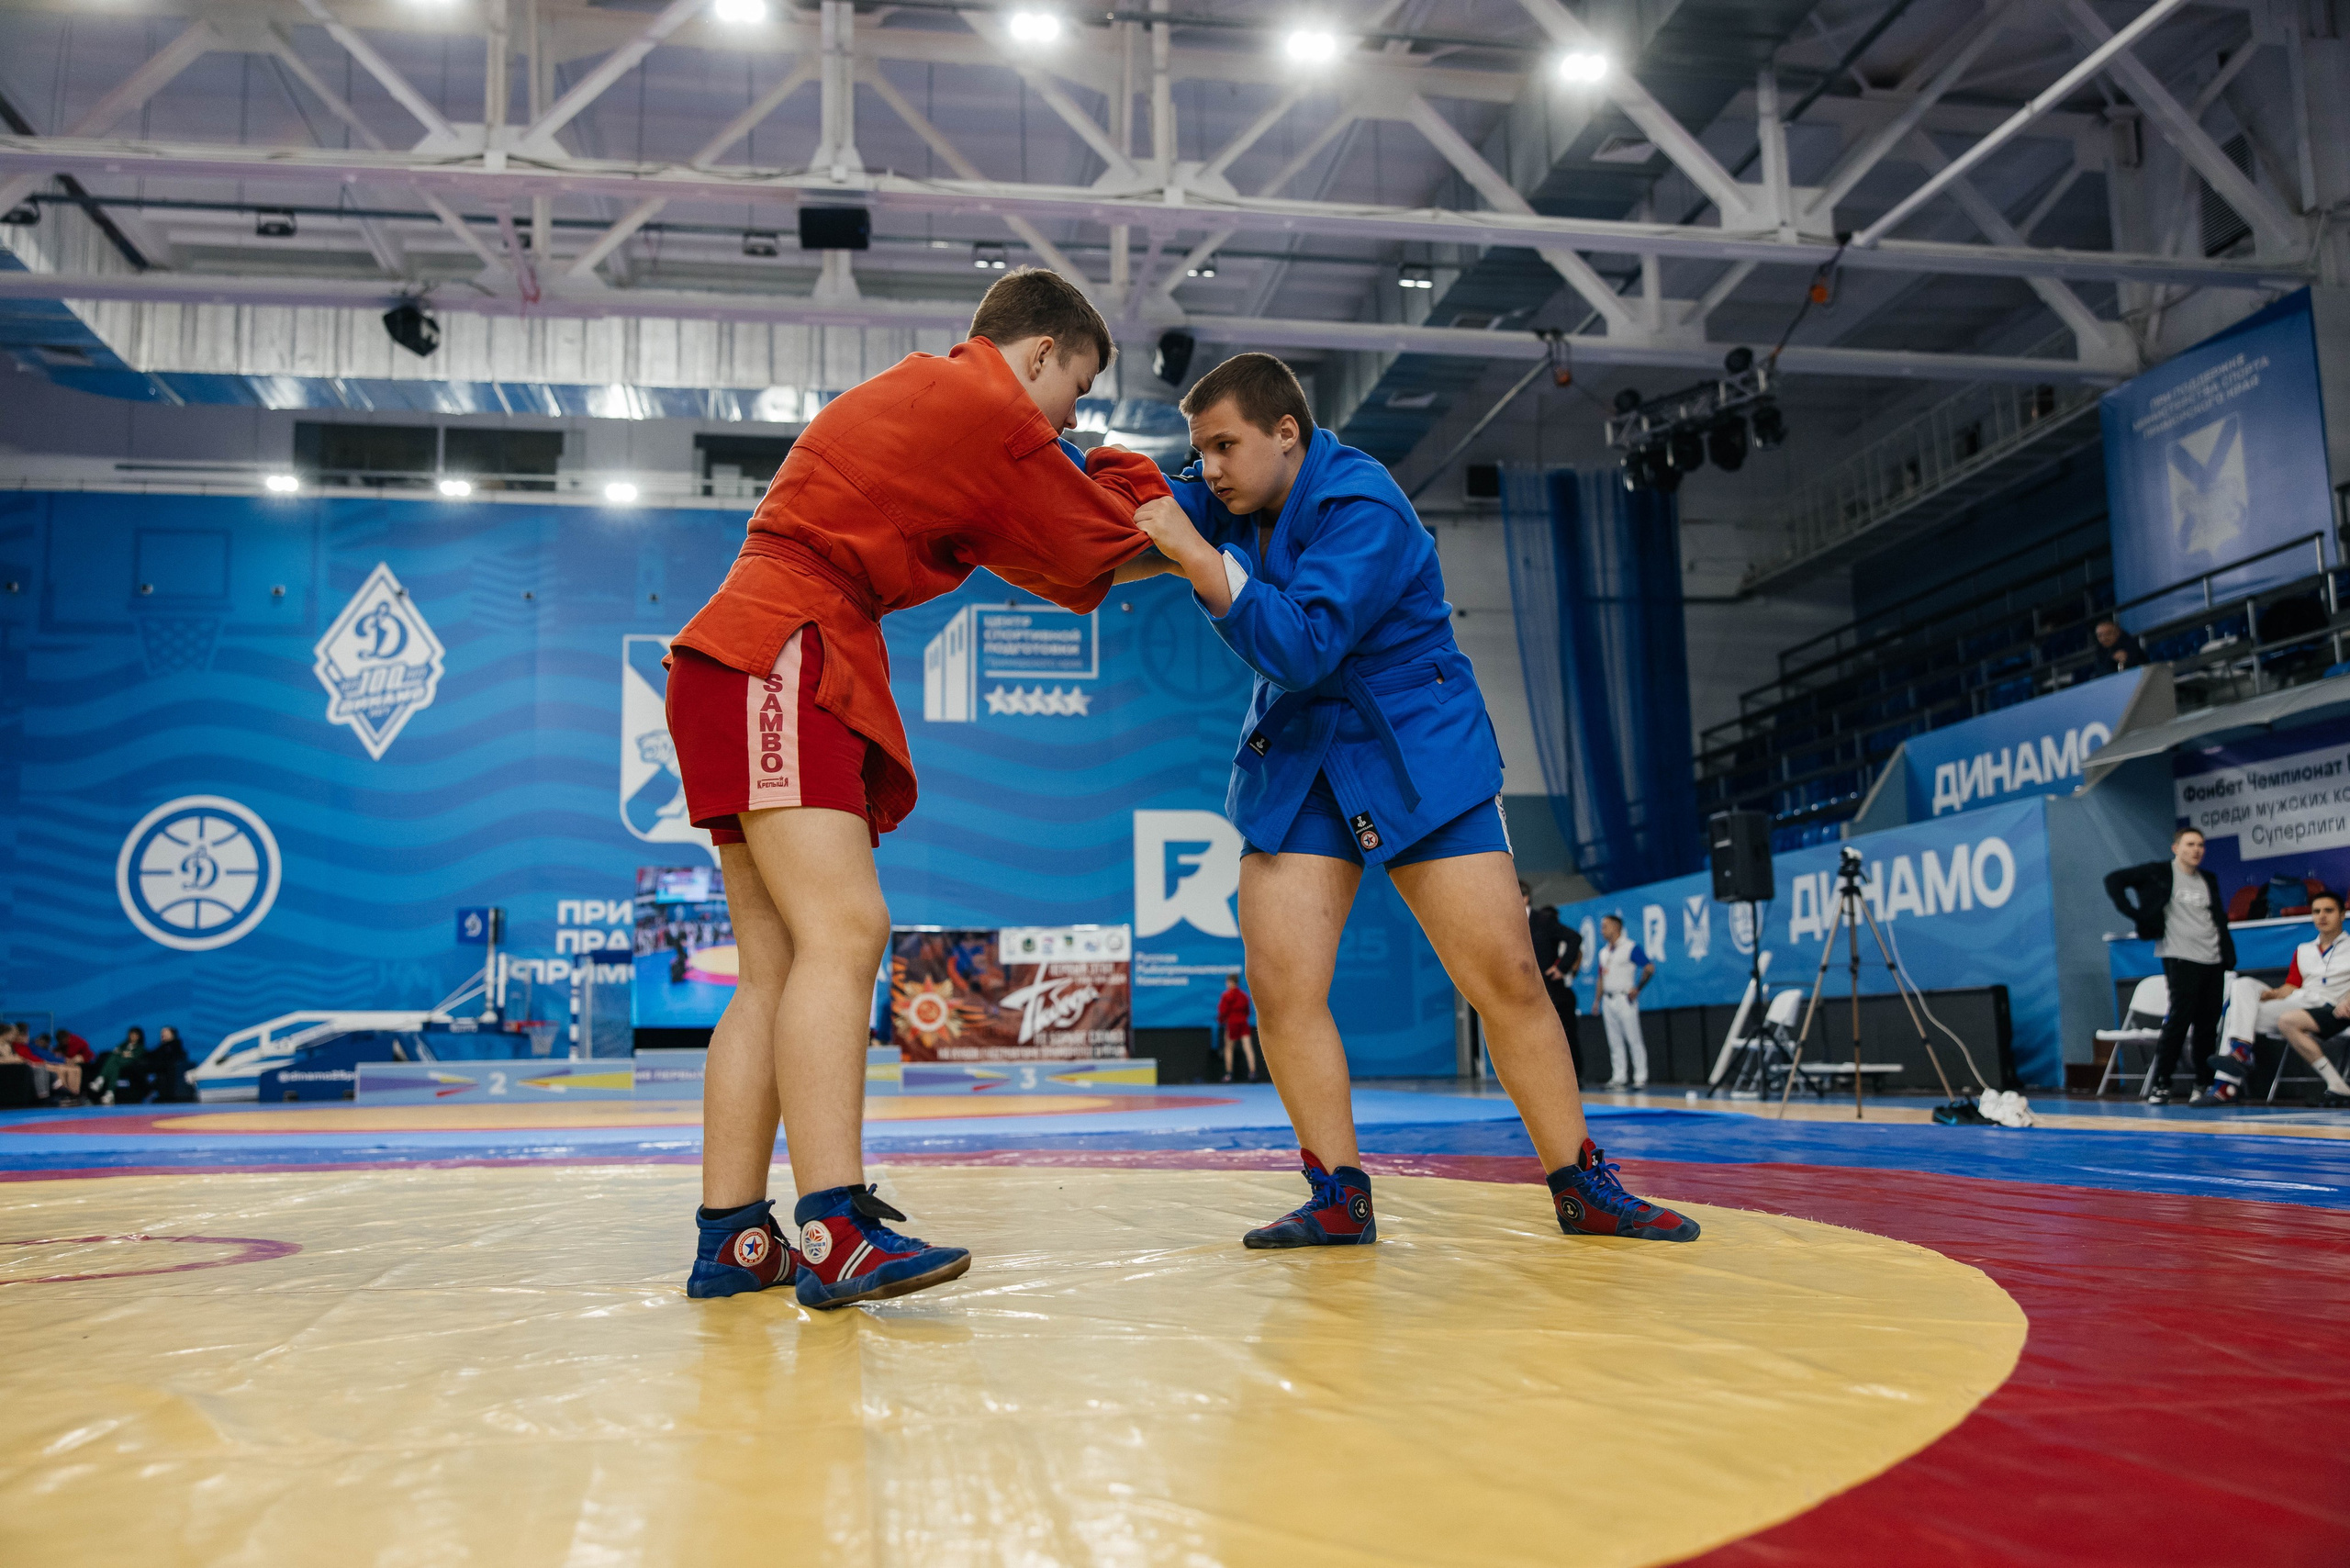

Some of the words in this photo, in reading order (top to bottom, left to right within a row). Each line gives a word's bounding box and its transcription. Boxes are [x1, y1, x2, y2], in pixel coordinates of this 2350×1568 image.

[759, 673, 783, 773] SAMBO
[2183, 778, 2244, 802] Фонбет
[2246, 759, 2343, 791] Чемпионат
[2200, 804, 2250, 829] среди
[2255, 790, 2327, 821] мужских
[2252, 815, 2345, 847] Суперлиги
[1790, 836, 2016, 945] ДИНАМО
[488, 1071, 507, 1095] 2
[1020, 1069, 1036, 1090] 3
